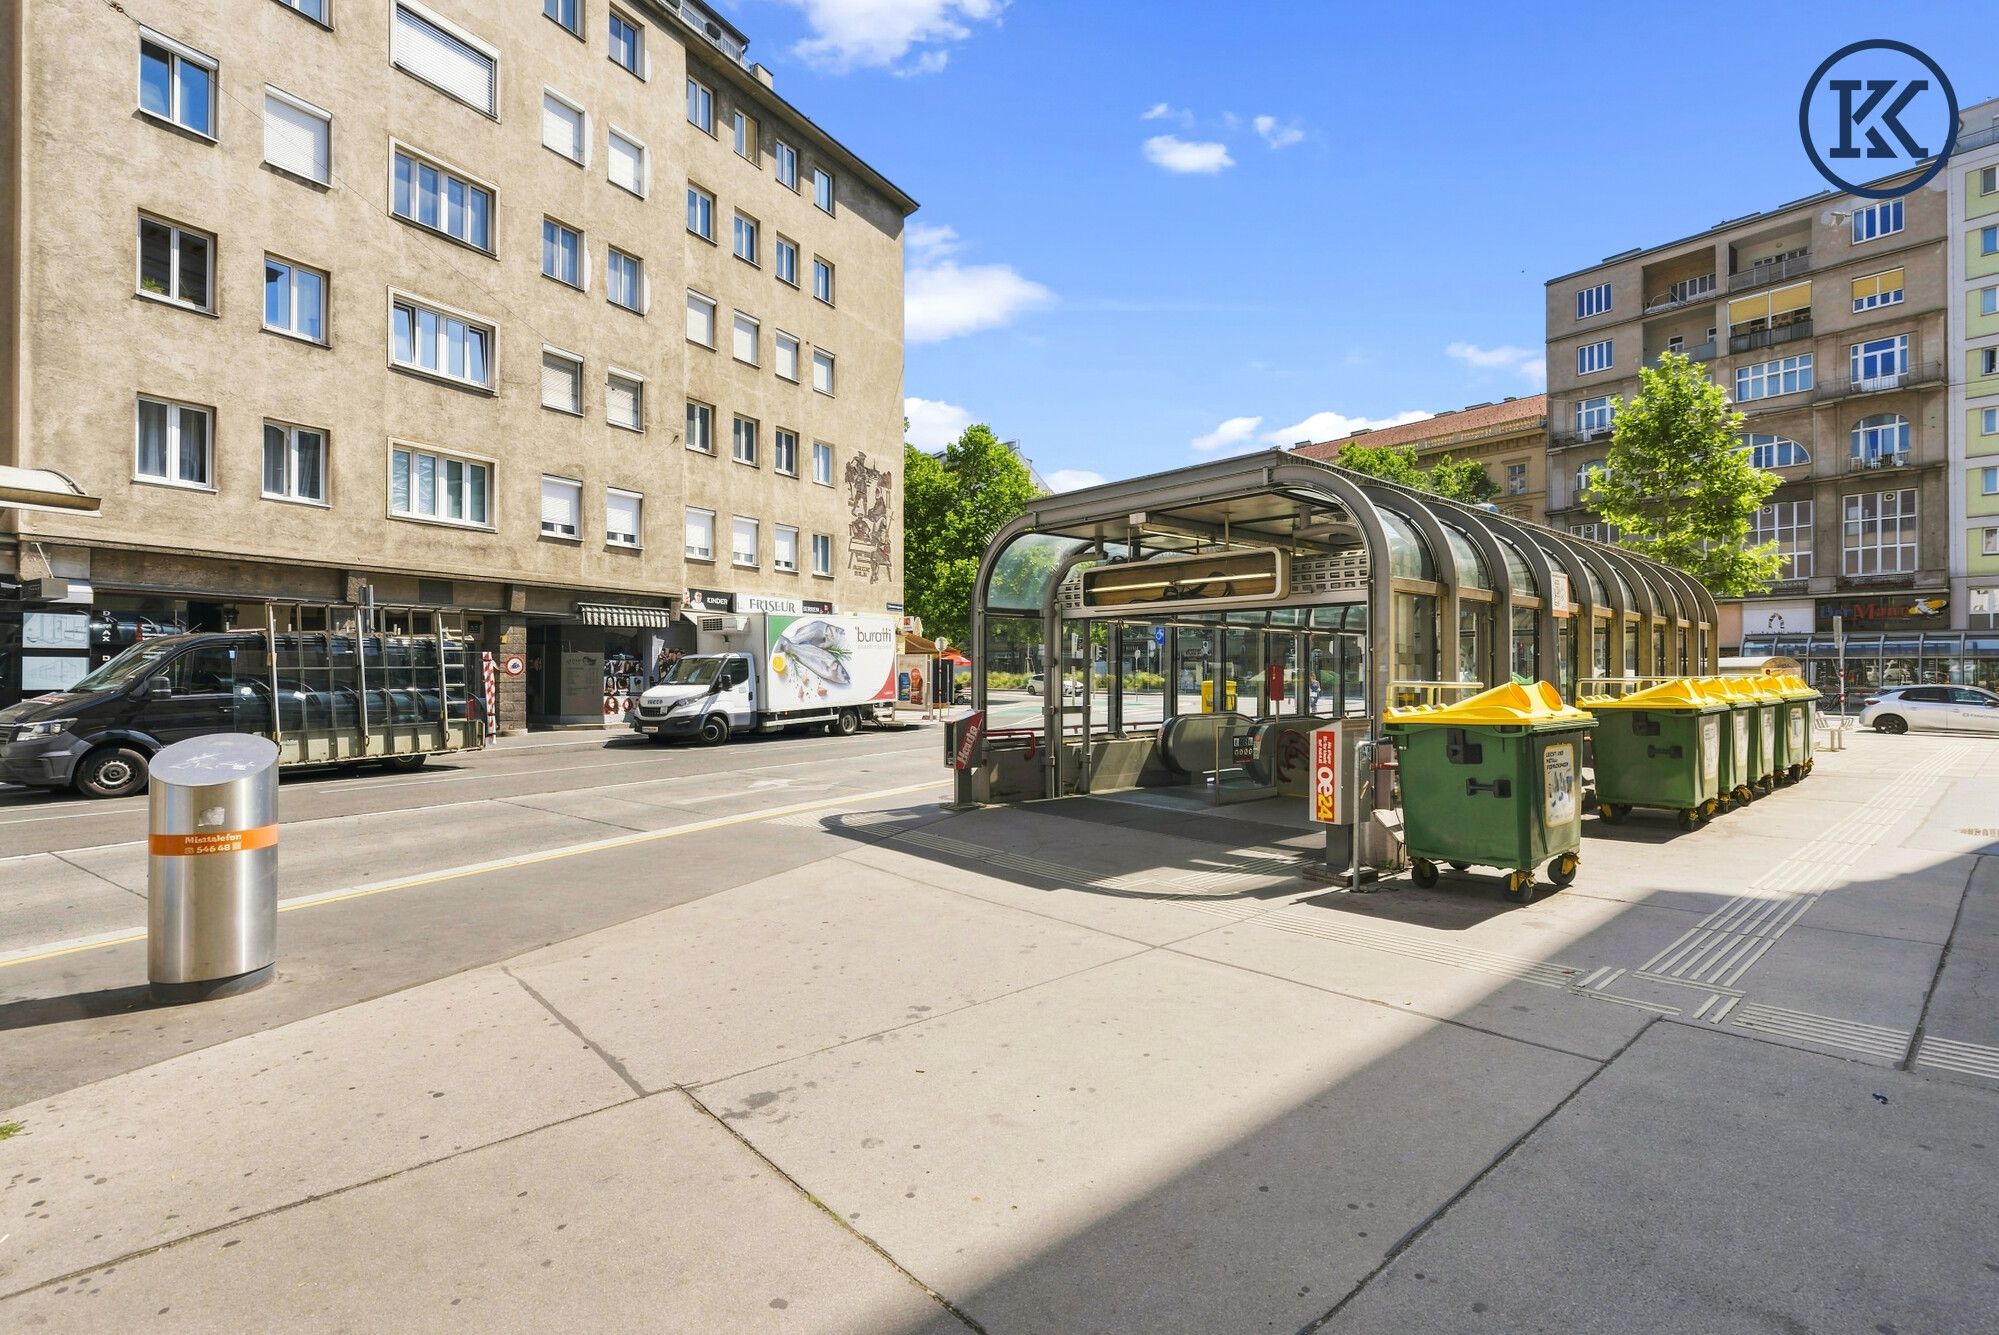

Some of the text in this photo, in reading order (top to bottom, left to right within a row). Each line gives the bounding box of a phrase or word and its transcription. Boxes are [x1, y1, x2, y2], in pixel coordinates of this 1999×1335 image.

[706, 596, 728, 605] KINDER
[749, 598, 796, 613] FRISEUR
[856, 626, 892, 643] buratti
[196, 843, 231, 854] 546 48
